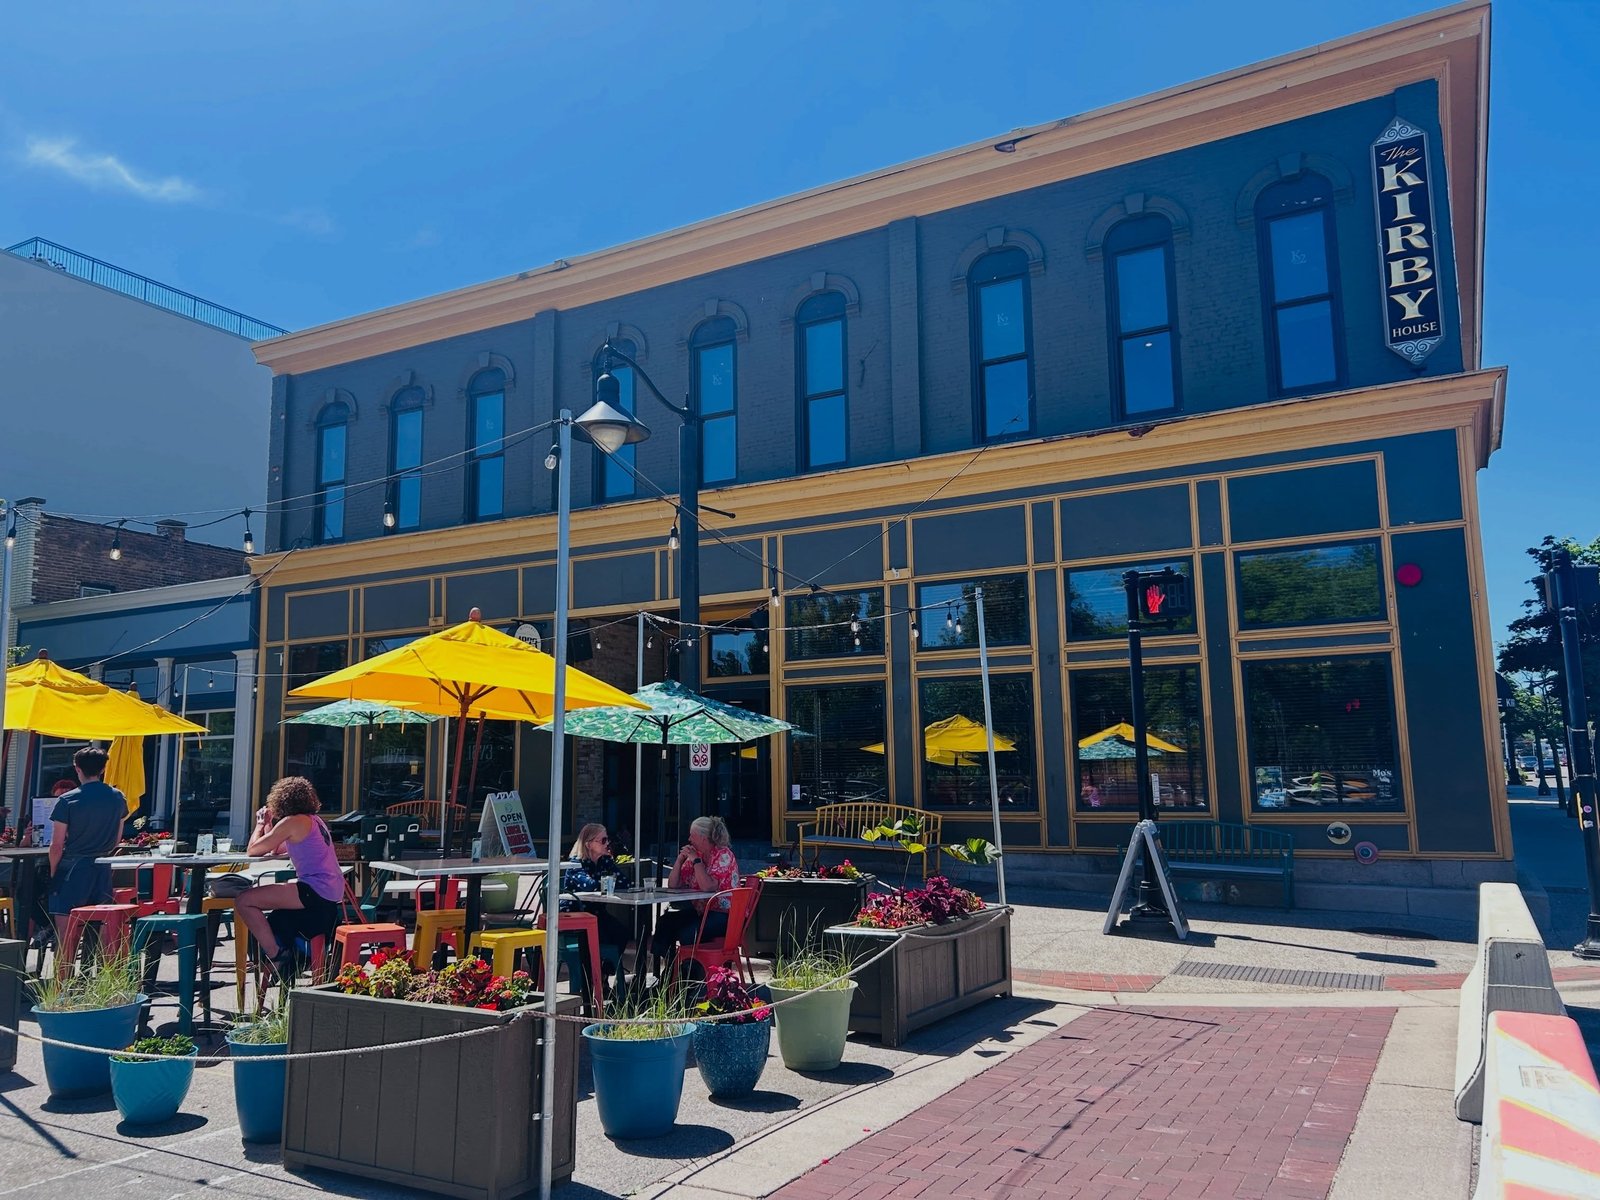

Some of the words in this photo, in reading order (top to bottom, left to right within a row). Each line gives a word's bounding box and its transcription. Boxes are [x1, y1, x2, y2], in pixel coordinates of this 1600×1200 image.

[1380, 145, 1419, 161] The
[1379, 157, 1434, 321] KIRBY
[1392, 321, 1438, 338] HOUSE
[500, 812, 523, 823] OPEN
